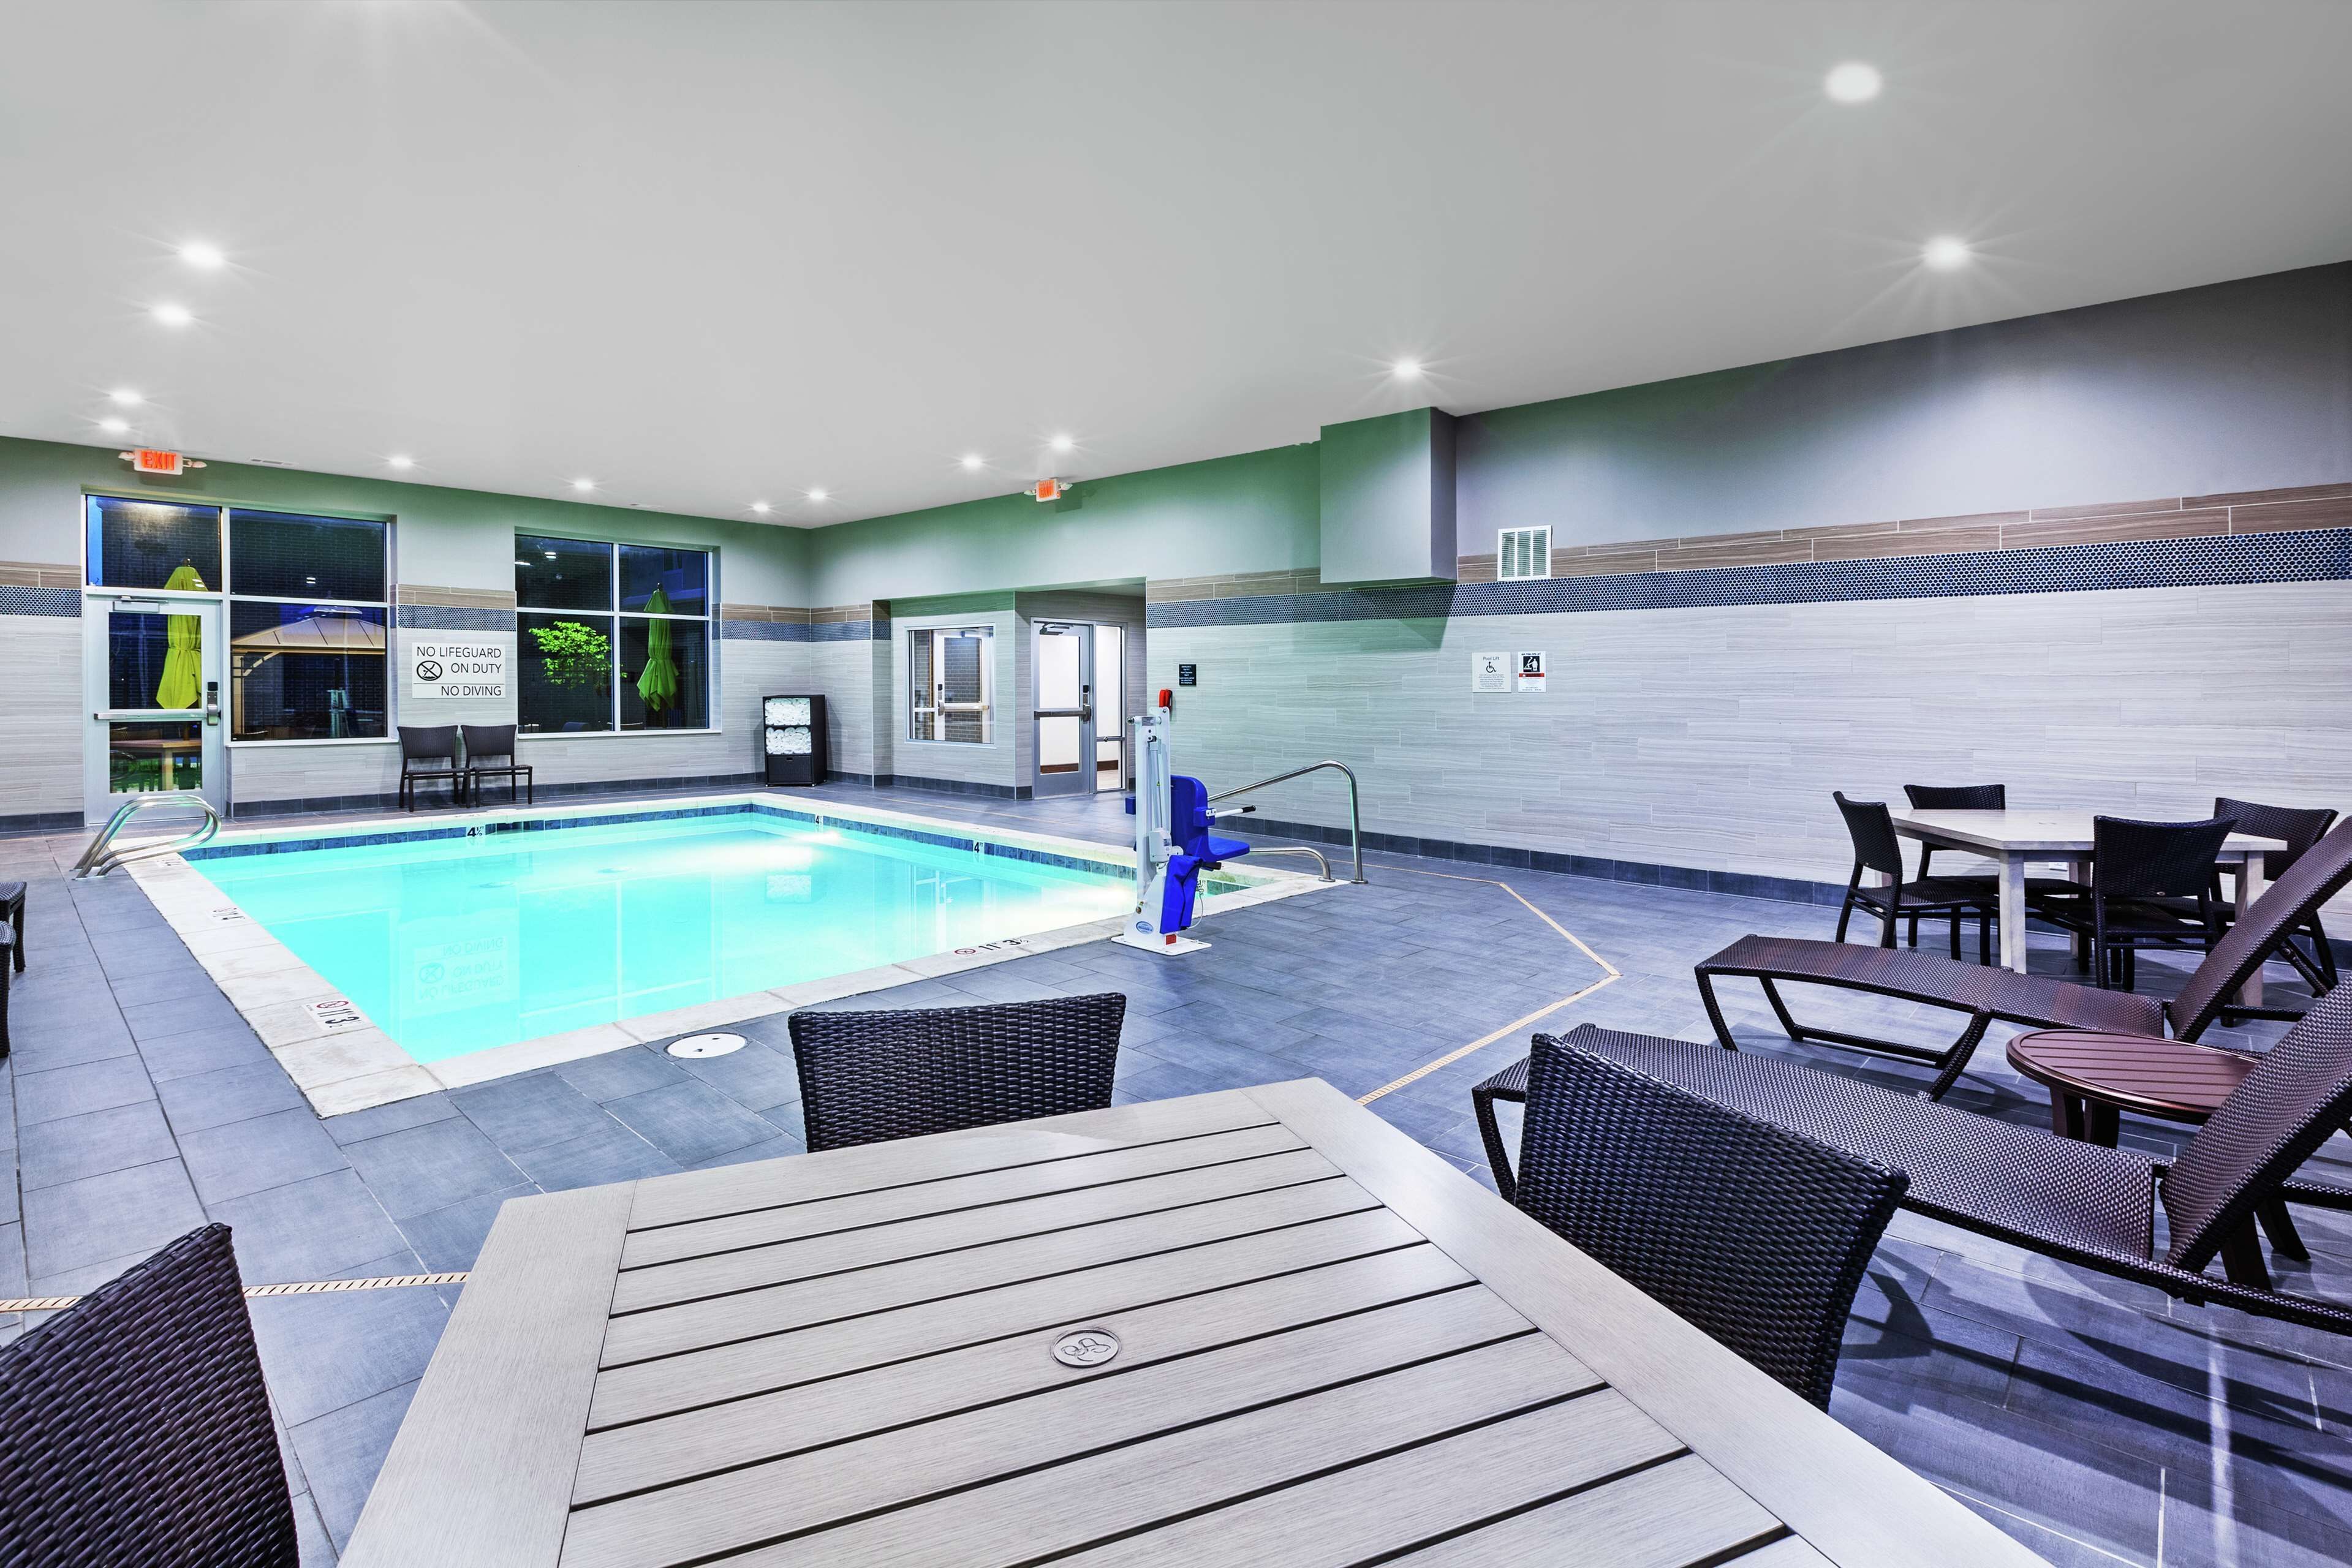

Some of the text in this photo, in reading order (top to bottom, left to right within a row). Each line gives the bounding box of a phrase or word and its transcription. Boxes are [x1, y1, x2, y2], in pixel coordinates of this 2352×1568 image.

[141, 450, 176, 470] EXIT
[417, 646, 501, 658] NO LIFEGUARD
[451, 663, 502, 673] ON DUTY
[441, 685, 502, 696] NO DIVING
